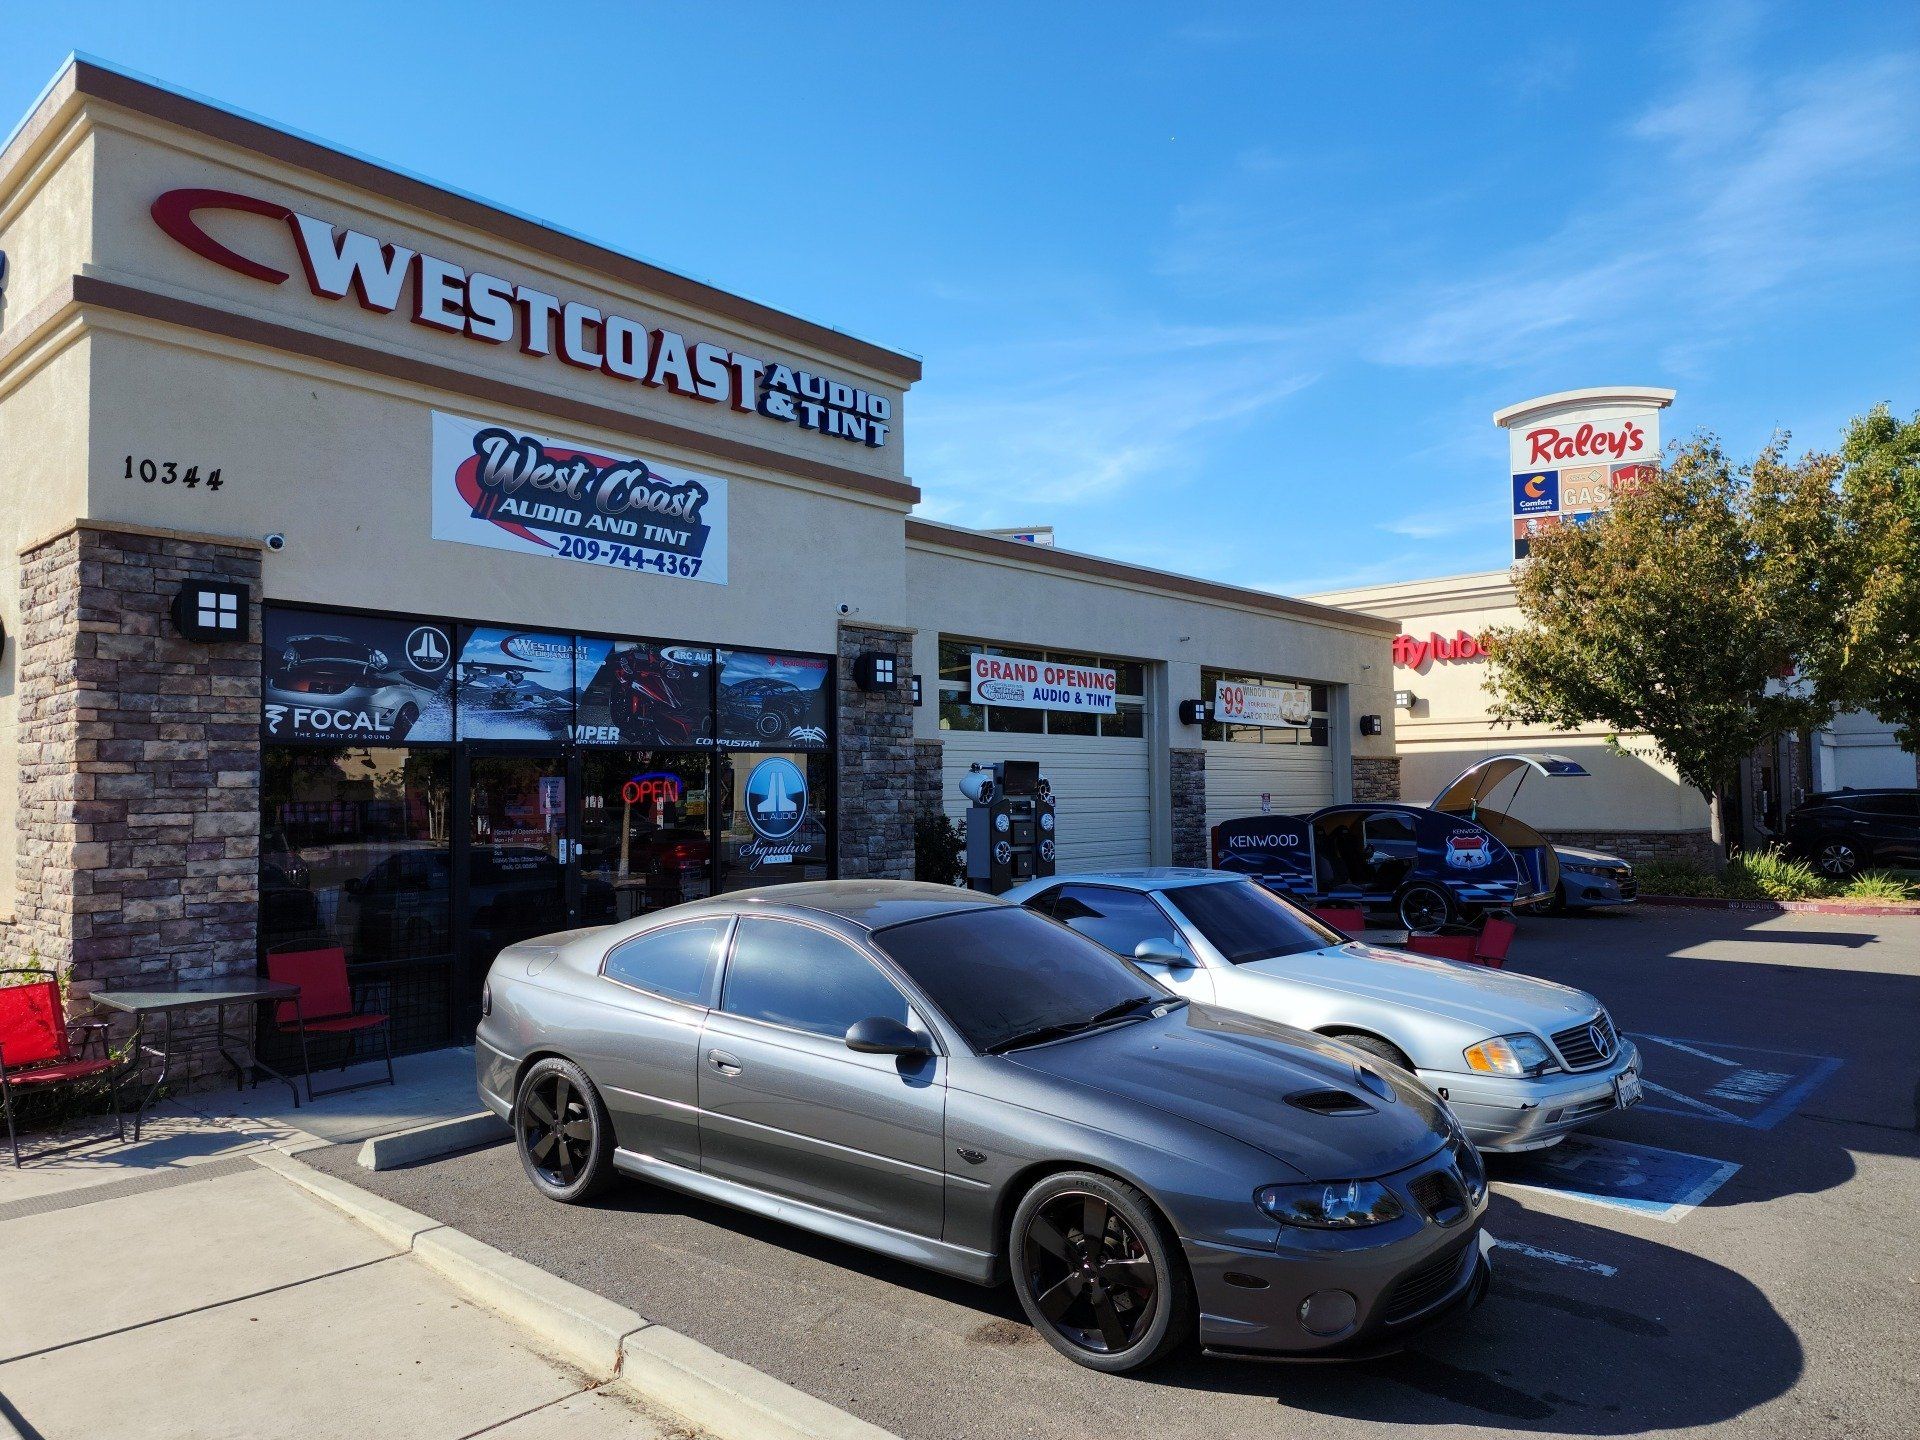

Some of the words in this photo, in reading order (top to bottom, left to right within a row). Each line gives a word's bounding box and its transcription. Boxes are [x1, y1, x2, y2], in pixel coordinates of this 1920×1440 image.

[290, 211, 765, 413] WESTCOAST
[760, 363, 891, 421] AUDIO
[757, 390, 797, 422] &
[799, 403, 890, 448] TINT
[1526, 421, 1644, 465] Raley's
[125, 455, 224, 491] 10344
[482, 436, 589, 501] West
[596, 467, 702, 523] Coast
[1520, 498, 1553, 508] Comfort
[1564, 485, 1606, 506] GAS
[498, 498, 581, 527] AUDIO
[585, 514, 638, 537] AND
[643, 524, 692, 547] TINT
[559, 536, 702, 577] 209-744-4367
[673, 651, 692, 661] ARC
[695, 652, 723, 664] AUDO
[976, 659, 1038, 683] GRAND
[1044, 668, 1115, 690] OPENING
[1033, 687, 1070, 703] AUDIO
[1075, 692, 1082, 704] &
[1086, 693, 1112, 707] TINT
[1243, 686, 1267, 698] WINDOW
[294, 709, 391, 732] FOCAL
[567, 724, 620, 741] VIPER
[622, 780, 678, 803] OPEN
[756, 813, 768, 821] JL
[770, 811, 798, 821] AUDIO
[1229, 833, 1299, 848] KENWOOD
[738, 838, 812, 870] Signature
[1779, 903, 1796, 911] FIRE
[1798, 904, 1819, 912] LANE
